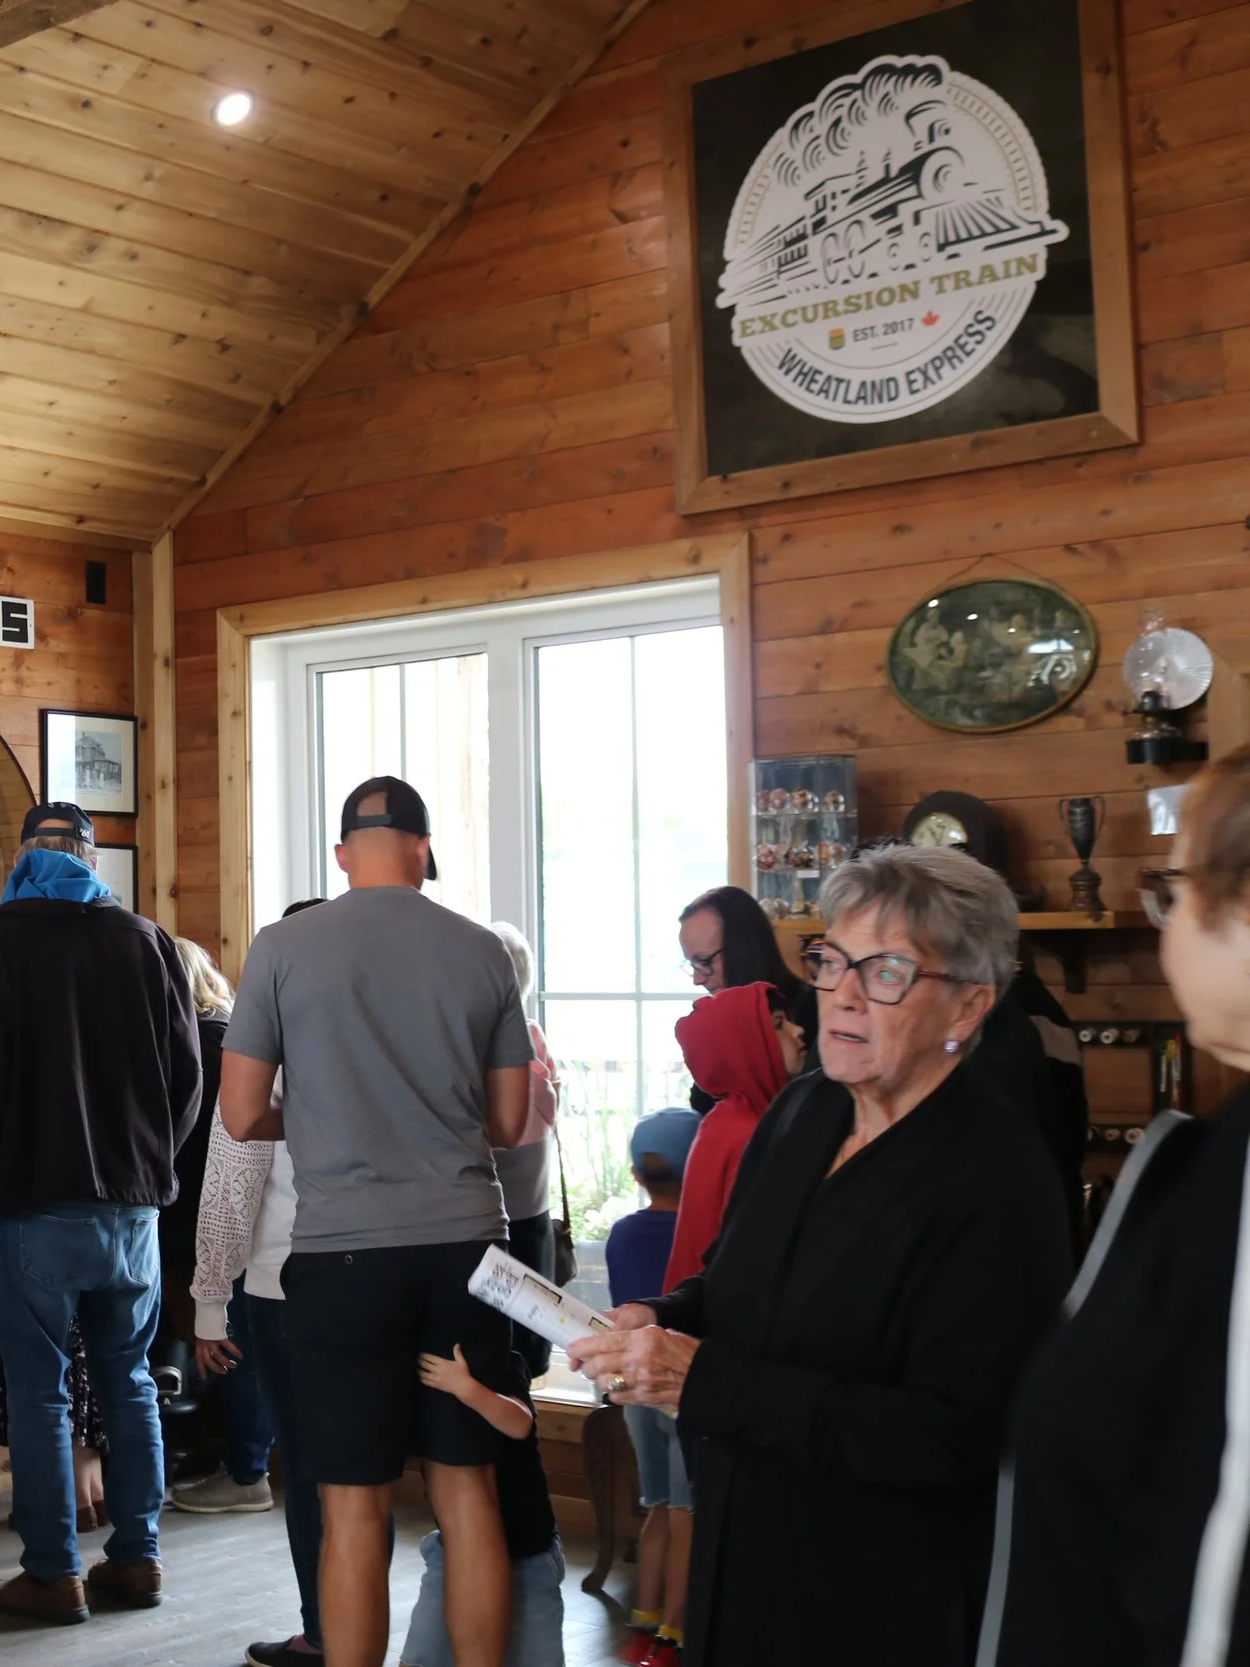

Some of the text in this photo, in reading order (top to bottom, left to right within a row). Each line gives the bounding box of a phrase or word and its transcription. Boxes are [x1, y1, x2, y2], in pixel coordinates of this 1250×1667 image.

[738, 253, 1040, 339] EXCURSION TRAIN
[852, 318, 914, 342] EST. 2017
[777, 309, 997, 405] WHEATLAND EXPRESS
